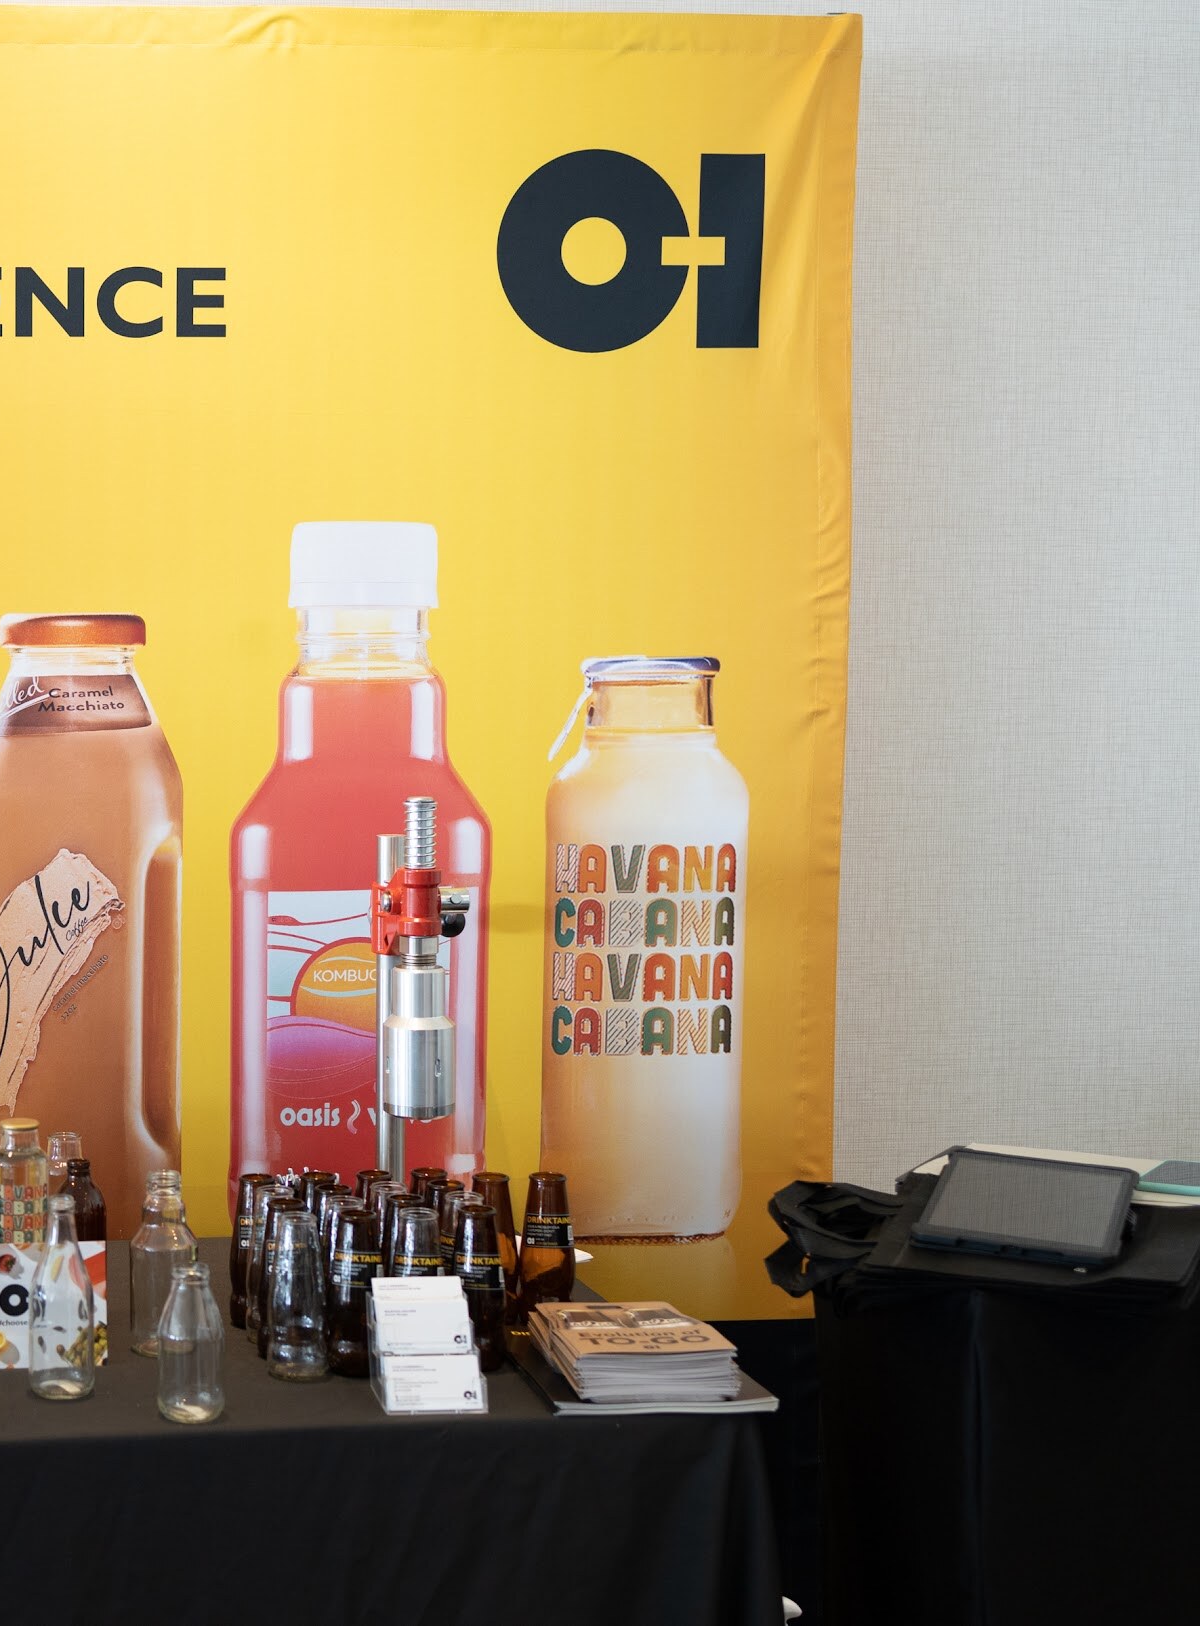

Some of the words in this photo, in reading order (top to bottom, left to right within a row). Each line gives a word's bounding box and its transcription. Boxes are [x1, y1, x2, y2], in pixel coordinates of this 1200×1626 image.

[49, 686, 113, 698] Caramel
[38, 701, 125, 712] Macchiato
[555, 843, 737, 893] HAVANA
[554, 897, 735, 948] CABANA
[77, 954, 109, 988] macchiato
[313, 969, 377, 983] KOMBUC
[552, 952, 733, 1002] HAVANA
[551, 1004, 732, 1056] CABANA
[279, 1102, 341, 1127] oasis
[578, 1330, 677, 1339] Evolution
[579, 1335, 711, 1346] TO-GO
